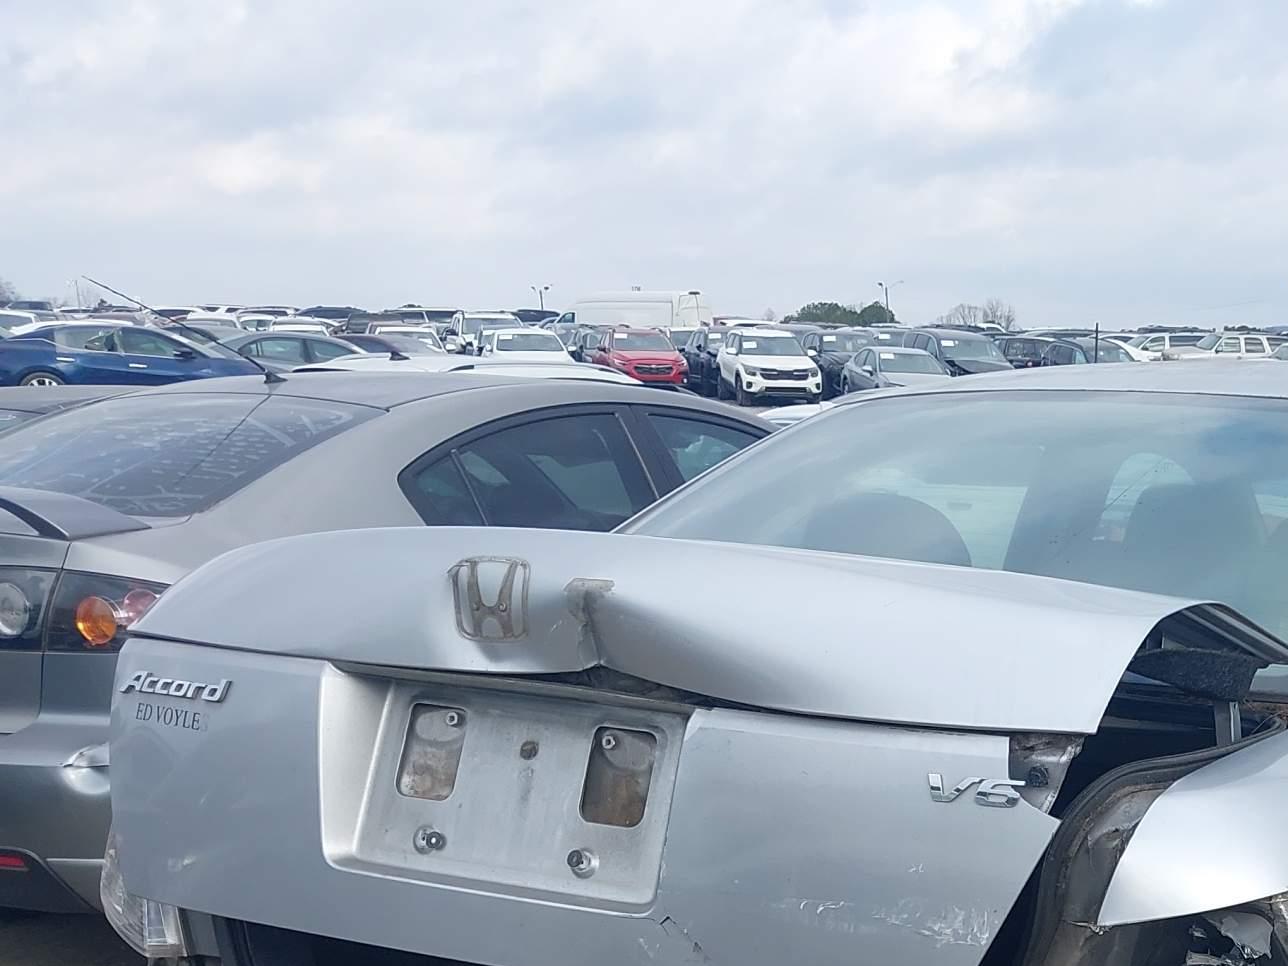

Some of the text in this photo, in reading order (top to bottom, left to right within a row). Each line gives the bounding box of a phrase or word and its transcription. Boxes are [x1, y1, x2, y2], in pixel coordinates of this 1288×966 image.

[120, 670, 232, 703] Accord
[136, 702, 153, 721] ED
[928, 773, 1026, 808] V6
